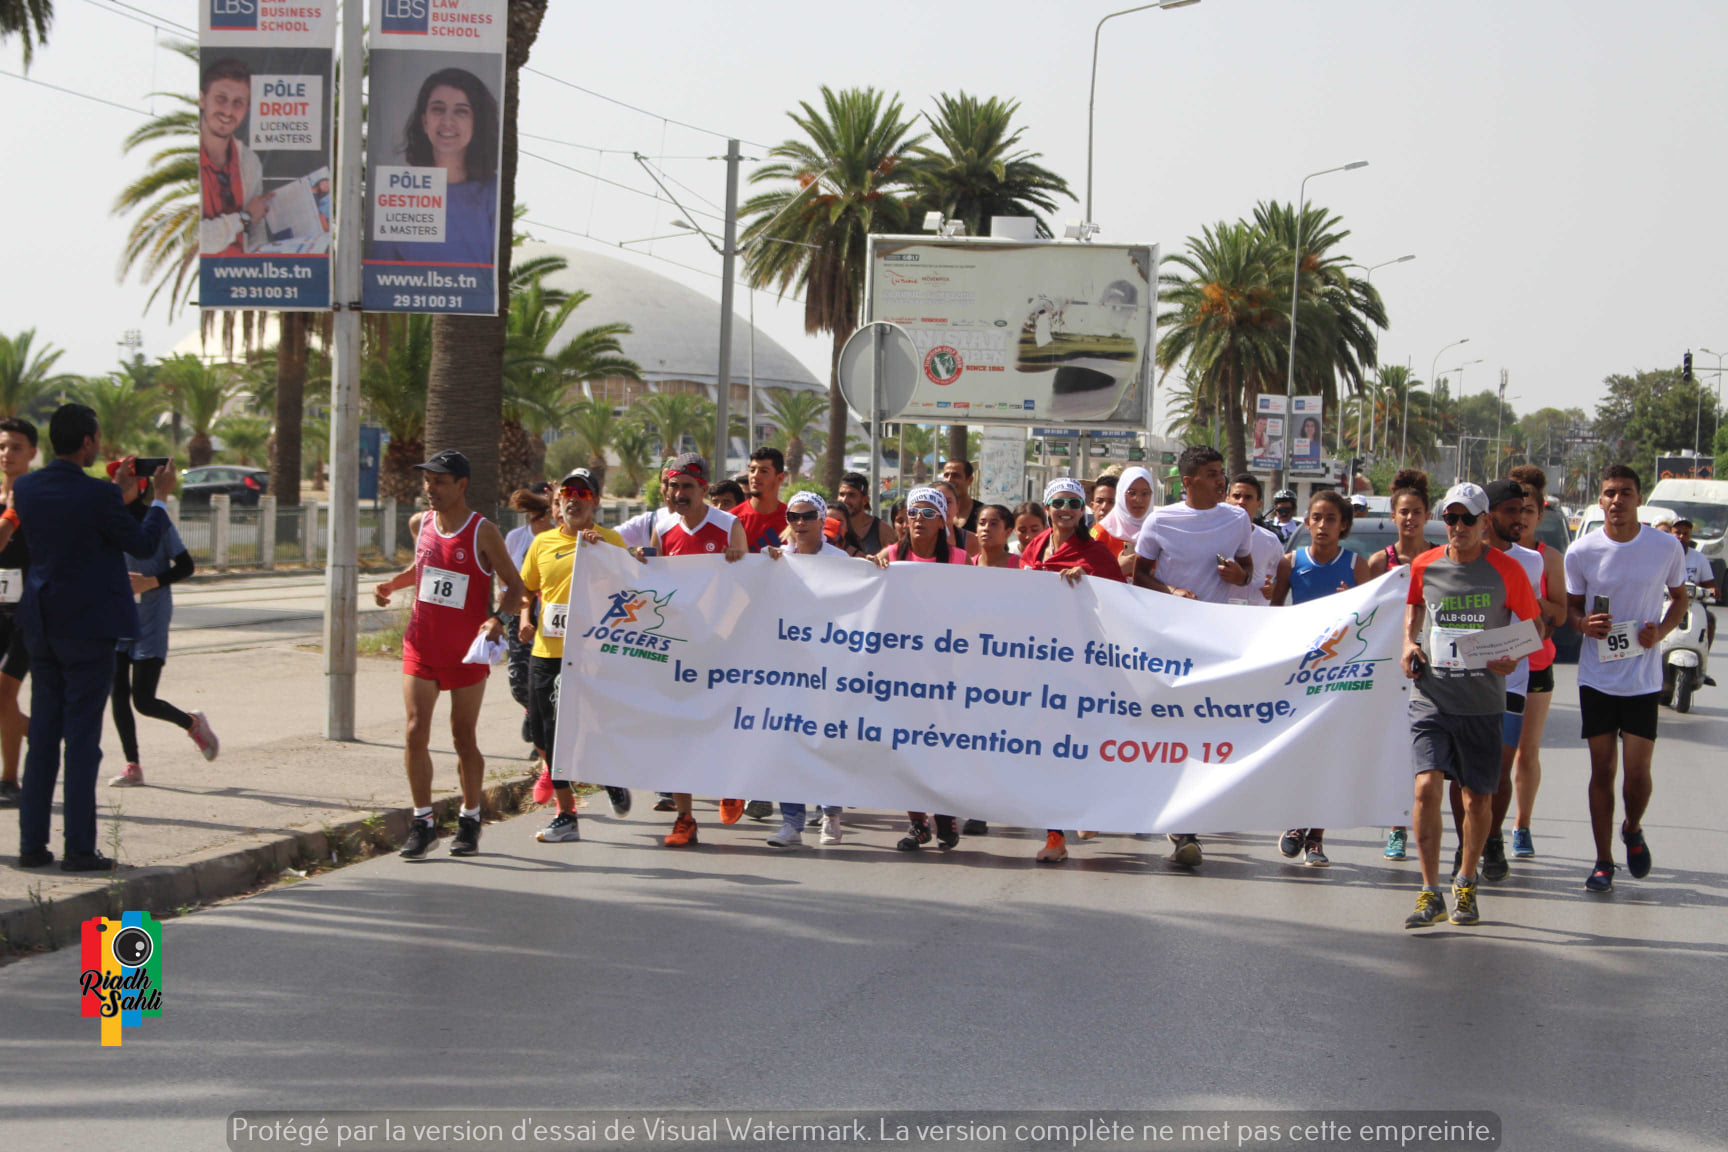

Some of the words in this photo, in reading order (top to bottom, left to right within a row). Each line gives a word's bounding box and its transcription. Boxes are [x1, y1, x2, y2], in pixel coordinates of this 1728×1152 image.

[261, 7, 322, 18] BUSINESS
[385, 0, 426, 18] LBS
[432, 12, 493, 24] BUSINESS
[261, 21, 310, 32] SCHOOL
[431, 26, 481, 38] SCHOOL
[263, 79, 306, 97] PÔLE
[260, 102, 310, 116] DROIT
[260, 121, 310, 131] LICENCES
[254, 133, 262, 144] &
[265, 133, 313, 144] MASTERS
[389, 171, 432, 189] PÔLE
[378, 194, 443, 209] GESTION
[385, 212, 434, 223] LICENCES
[379, 224, 387, 234] &
[390, 225, 438, 236] MASTERS
[213, 262, 312, 279] www.lbs.tn
[376, 271, 477, 288] www.lbs.tn
[230, 286, 247, 298] 29
[249, 286, 261, 298] 31
[264, 287, 282, 298] 00
[284, 287, 298, 299] 31
[393, 295, 410, 307] 29
[412, 295, 426, 307] 31
[429, 296, 446, 307] 00
[448, 296, 462, 308] 31
[433, 579, 453, 597] 18
[1441, 593, 1491, 611] HELFER
[778, 618, 812, 642] Les
[820, 622, 924, 653] Joggers
[934, 629, 969, 654] de
[979, 633, 1075, 662] Tunisie
[1084, 640, 1194, 676] félicitent
[1607, 633, 1630, 651] 95
[600, 643, 619, 655] DE
[622, 646, 669, 663] TUNISIE
[674, 660, 698, 683] le
[707, 666, 827, 690] personnel
[835, 671, 956, 702] soignant
[965, 684, 1032, 708] pour
[1041, 684, 1067, 710] la
[1077, 691, 1143, 719] prise
[1151, 702, 1185, 718] en
[1194, 696, 1297, 724] charge,
[1306, 685, 1323, 696] DE
[1324, 680, 1374, 692] TUNISIE
[733, 707, 755, 730] la
[761, 708, 818, 736] lutte
[823, 719, 848, 740] et
[857, 717, 882, 742] la
[892, 723, 1042, 757] prévention
[1053, 735, 1089, 760] du
[1100, 740, 1188, 763] COVID
[1202, 742, 1234, 763] 19
